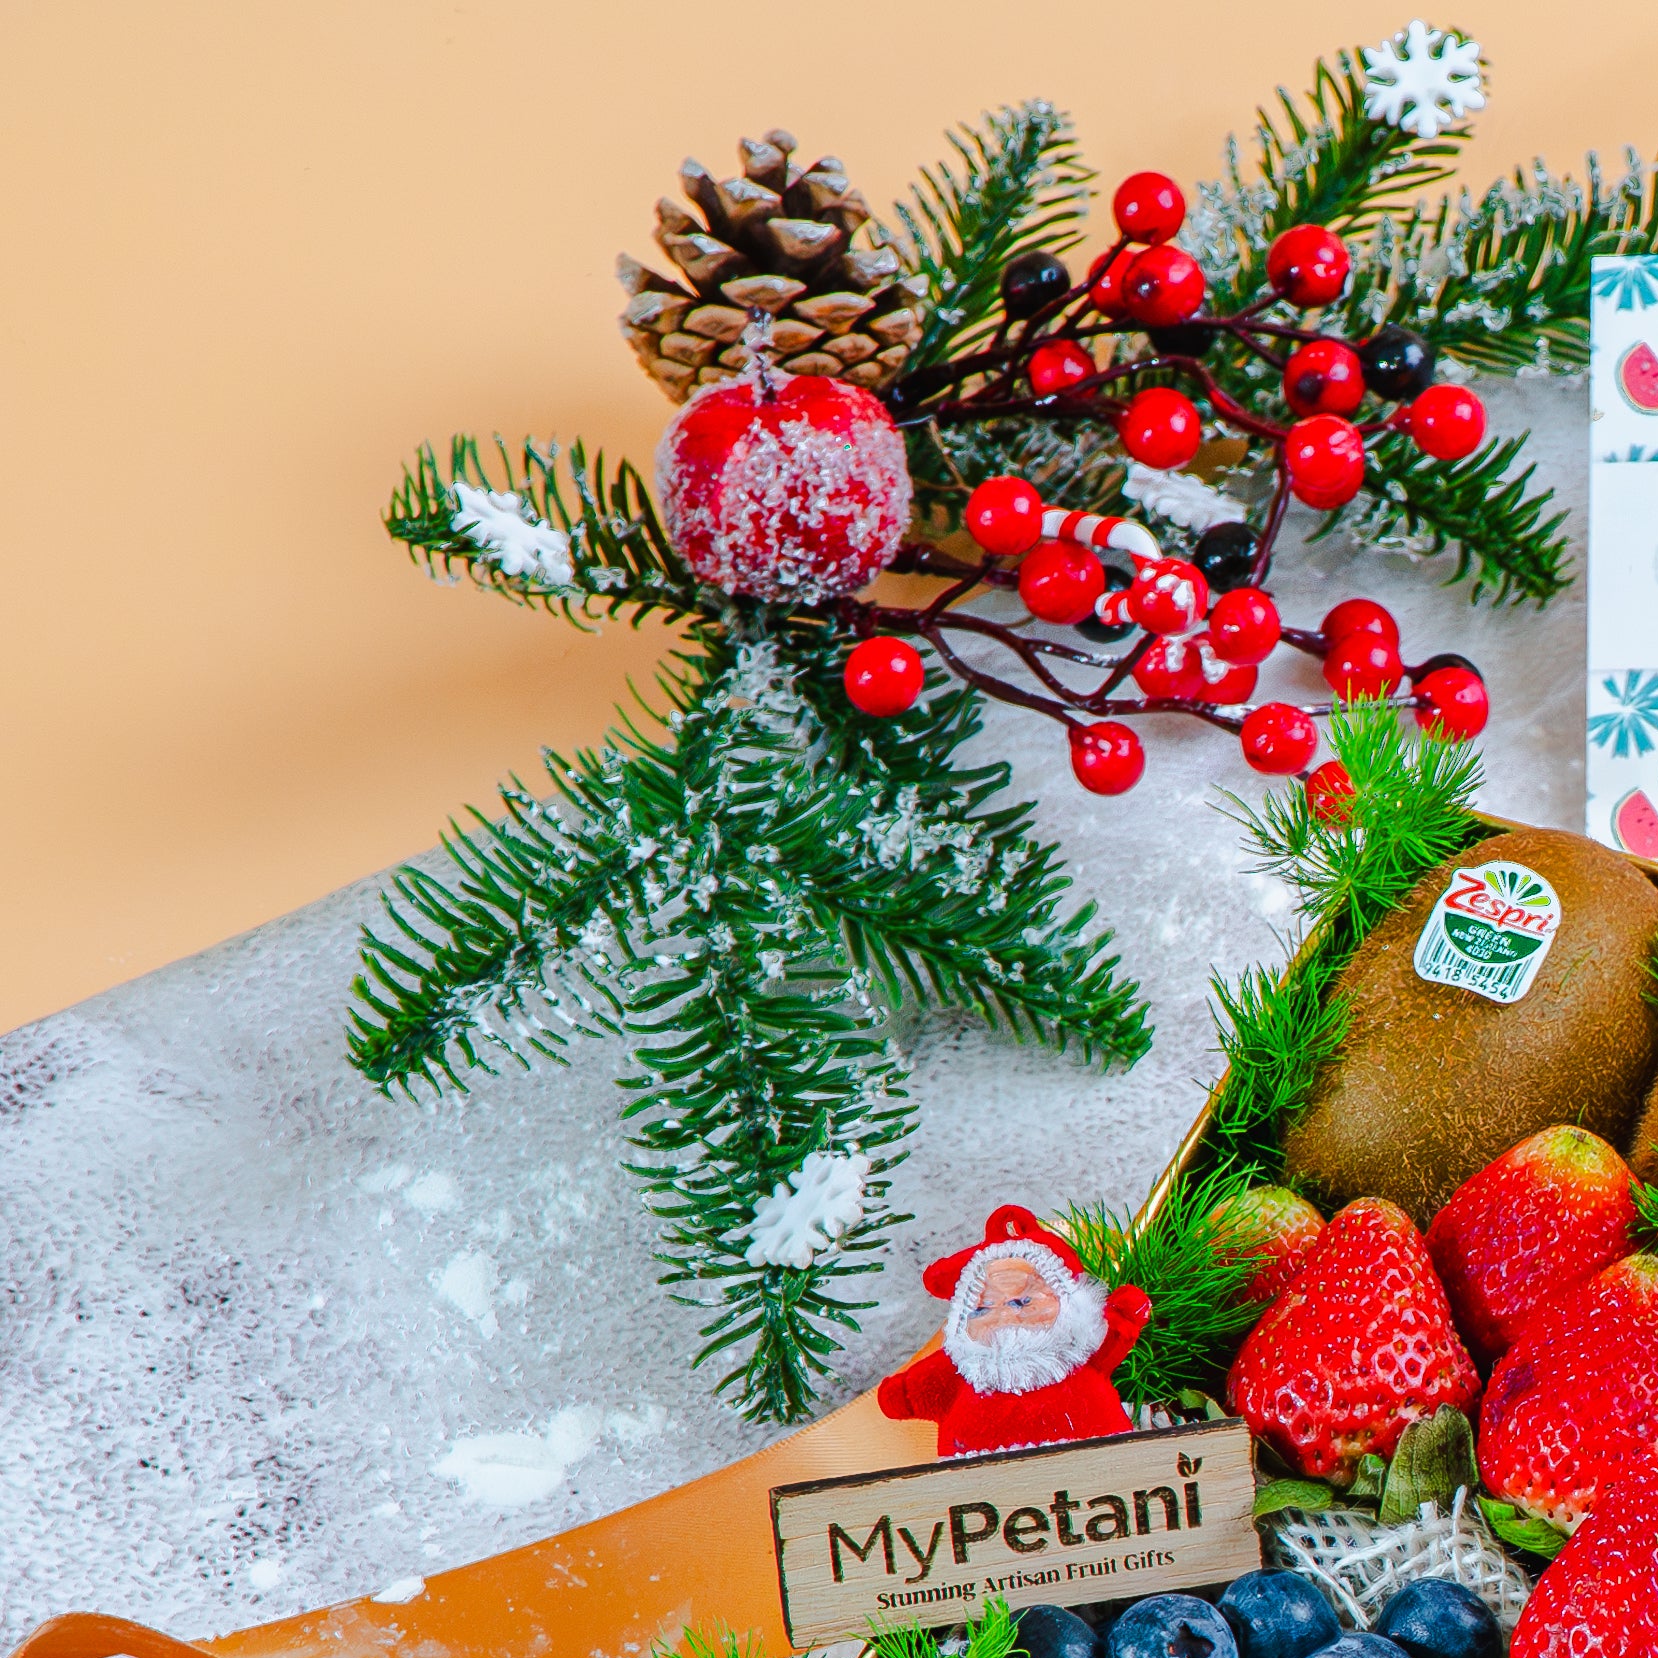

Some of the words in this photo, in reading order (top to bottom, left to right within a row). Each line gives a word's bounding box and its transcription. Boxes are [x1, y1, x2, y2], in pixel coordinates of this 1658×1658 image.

[1444, 872, 1554, 932] Zespri
[1467, 924, 1511, 947] GREEN
[826, 1451, 1203, 1584] MyPetani
[876, 1580, 976, 1610] Stunning
[982, 1566, 1061, 1594] Artisan
[1066, 1556, 1118, 1581] Fruit
[1123, 1548, 1176, 1571] Gifts
